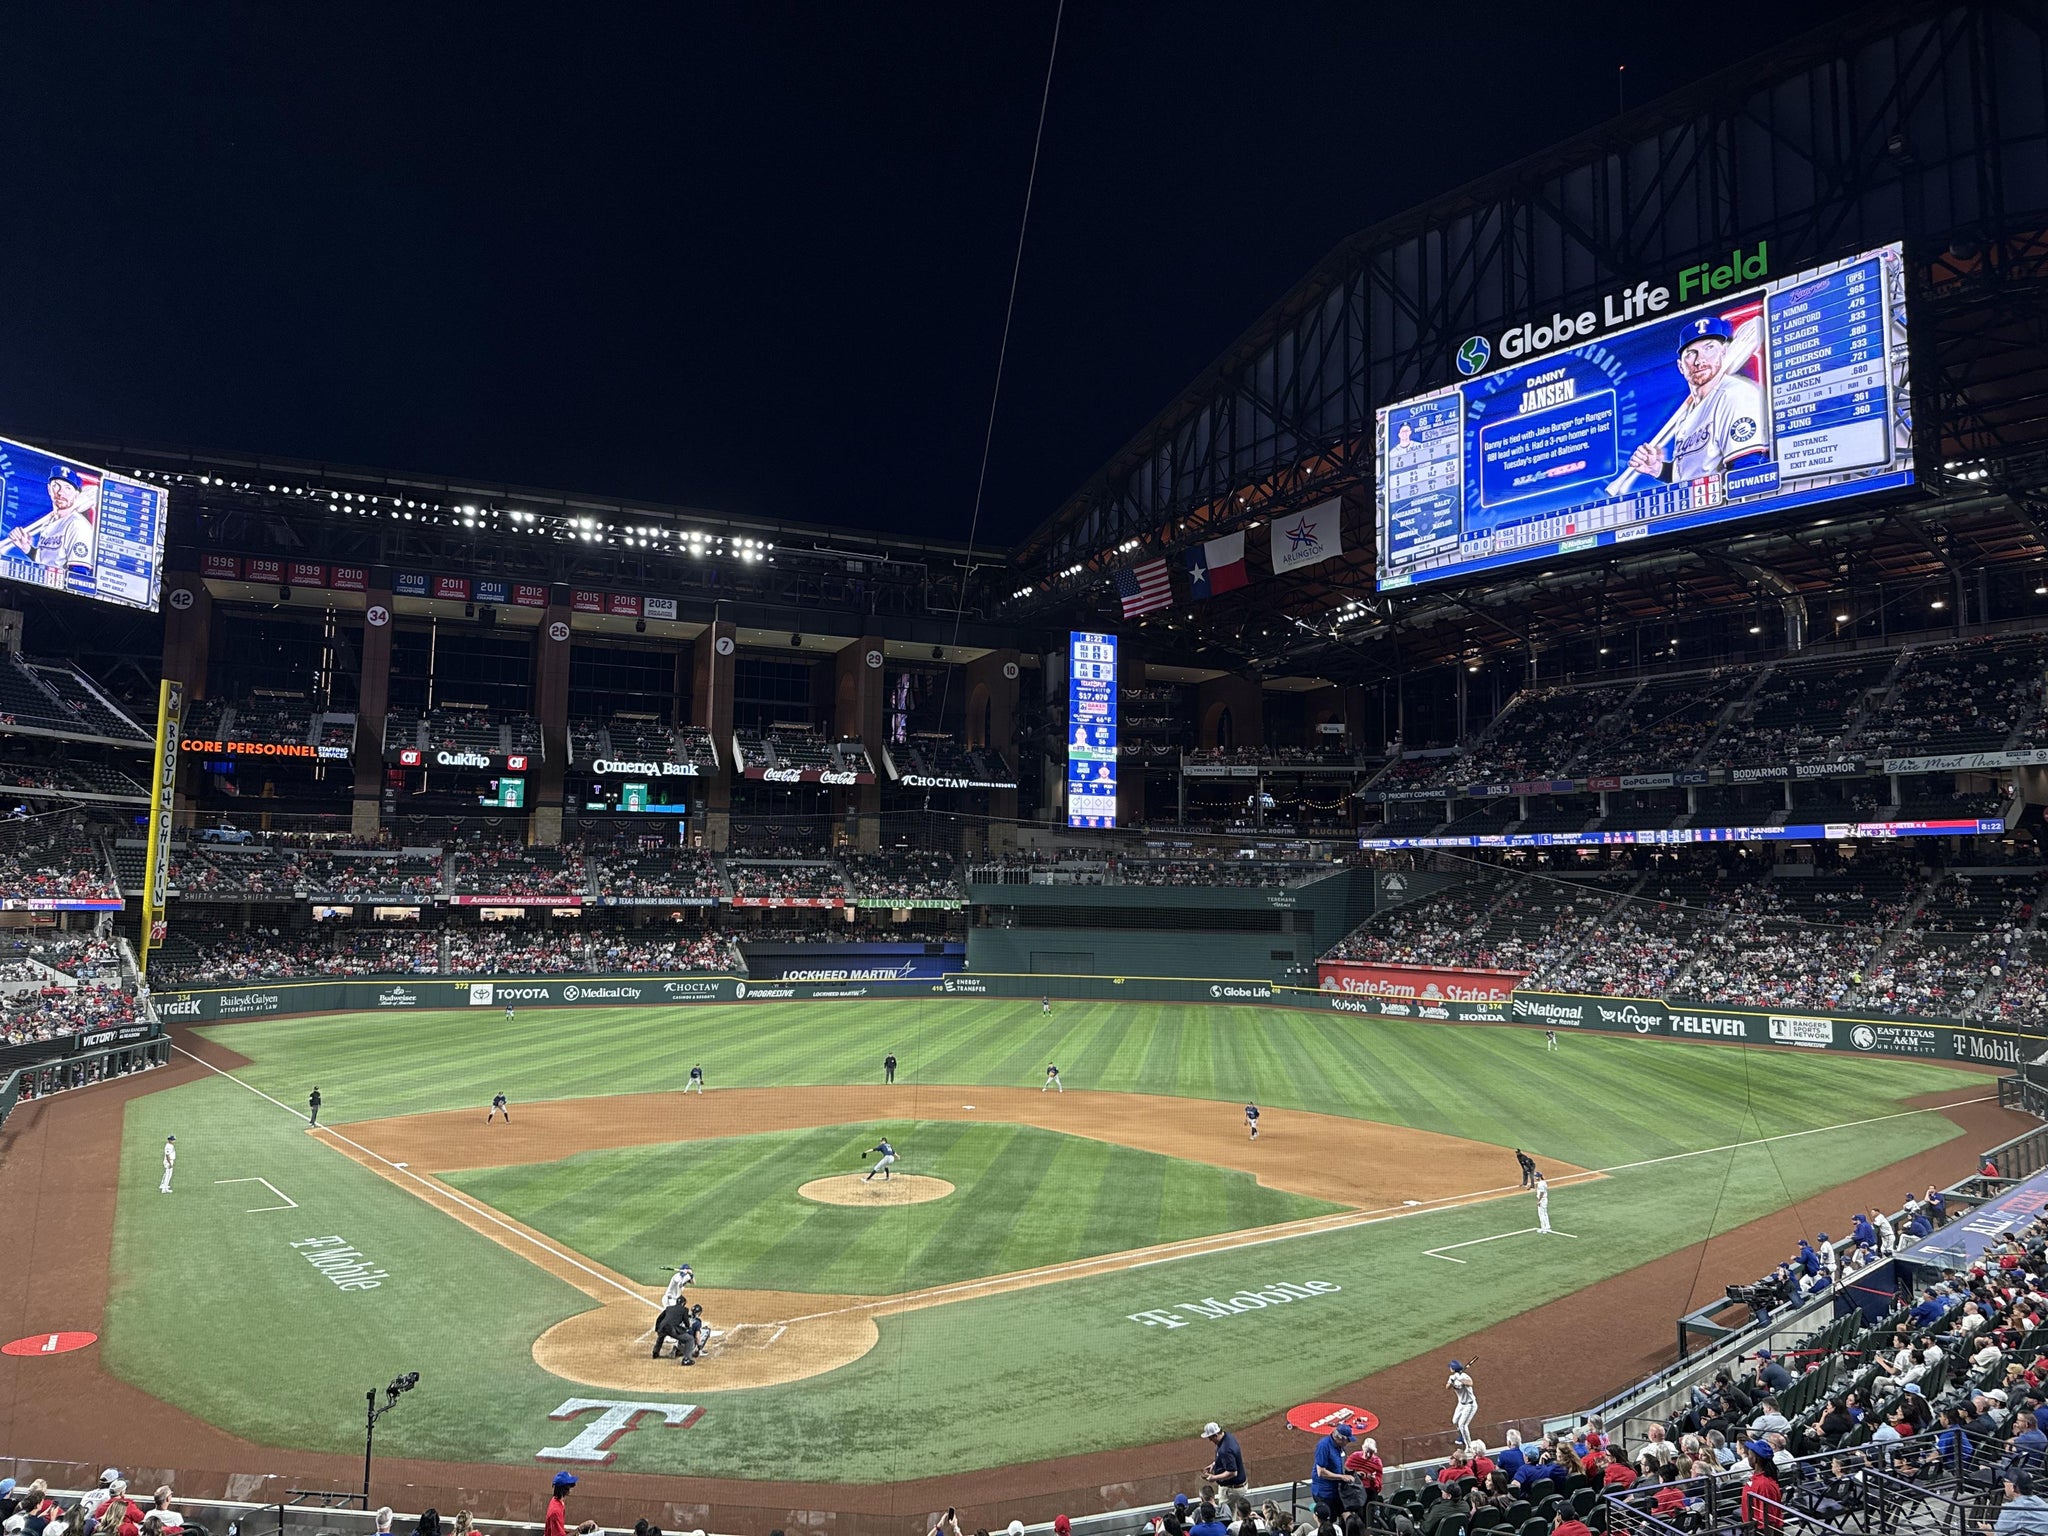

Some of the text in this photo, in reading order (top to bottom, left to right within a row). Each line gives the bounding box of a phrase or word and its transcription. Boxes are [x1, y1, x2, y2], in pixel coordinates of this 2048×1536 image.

[1499, 240, 1768, 359] Globe Life Field
[1783, 303, 1808, 318] NIMMO
[1784, 312, 1820, 330] LANGFORD
[1784, 326, 1818, 342] SEAGER
[1784, 338, 1820, 355] BURGER
[1785, 347, 1832, 368] PEDERSON
[1526, 368, 1566, 388] DANNY
[1786, 364, 1820, 380] CARTER
[1786, 376, 1821, 392] JANSEN
[1519, 378, 1575, 414] JANSEN
[1788, 404, 1816, 417] SMITH
[1484, 409, 1612, 451] Danny tied with Jake Burger for Rangers
[1788, 418, 1811, 430] JUNG
[1498, 422, 1610, 459] lead with Had homer last
[1793, 435, 1828, 448] DISTANCE
[1784, 444, 1838, 460] EXIT VELOCITY
[1504, 452, 1550, 470] Tuesday's game
[1790, 456, 1833, 470] EXIT ANGLE
[1729, 472, 1777, 490] CUTWATER
[1618, 528, 1646, 539] LAST AB
[1283, 544, 1324, 564] ARLINGTON
[208, 556, 234, 568] 1996
[253, 560, 278, 572] 1998
[295, 564, 320, 576] 1999
[338, 568, 362, 580] 2010
[400, 574, 424, 585] 2010
[442, 579, 463, 589] 2011
[480, 582, 501, 592] 2011
[520, 586, 542, 596] 2012
[172, 593, 190, 606] 42
[576, 592, 598, 602] 2015
[614, 596, 636, 606] 2016
[649, 599, 672, 610] 2023
[370, 610, 386, 622] 34
[552, 626, 568, 638] 26
[722, 641, 728, 651] 7
[869, 654, 880, 664] 29
[1006, 666, 1016, 676] 10
[163, 725, 176, 782] ROOT
[181, 740, 318, 758] CORE PERSONNEL
[402, 752, 418, 764] QT
[437, 751, 490, 768] QuikTrip
[508, 757, 524, 768] QT
[1886, 760, 1920, 772] Blue
[1924, 758, 1963, 769] Mint
[1971, 754, 2001, 767] Thai
[662, 762, 699, 776] Bank
[1733, 767, 1788, 779] BODYARMOR
[1796, 763, 1855, 775] BODYARMOR
[908, 774, 969, 788] CHOCTAW
[1623, 777, 1670, 786] GoPGL.com
[1684, 774, 1706, 783] PGL
[1486, 786, 1510, 795] 105.3
[163, 789, 172, 806] 4
[470, 896, 572, 905] America's Best Network
[869, 900, 960, 909] LUXOR STAFFING
[782, 970, 897, 980] LOCKHEED MARTIN
[496, 988, 549, 1000] TOYOTA
[581, 987, 641, 1000] Medical City
[669, 983, 719, 992] CHOCTAW
[1224, 987, 1270, 997] Globe Life
[156, 1000, 201, 1015] ATGEEK
[1332, 999, 1367, 1012] Kubota
[1618, 1005, 1662, 1033] Kroger
[1772, 1020, 1787, 1037] T
[1877, 1027, 1935, 1038] EAST TEXAS
[83, 1031, 115, 1047] VICTORY
[1893, 1036, 1918, 1045] A&M
[1877, 1045, 1935, 1054] UNIVERSITY
[1175, 1280, 1342, 1320] Mobile
[536, 1397, 707, 1466] T
